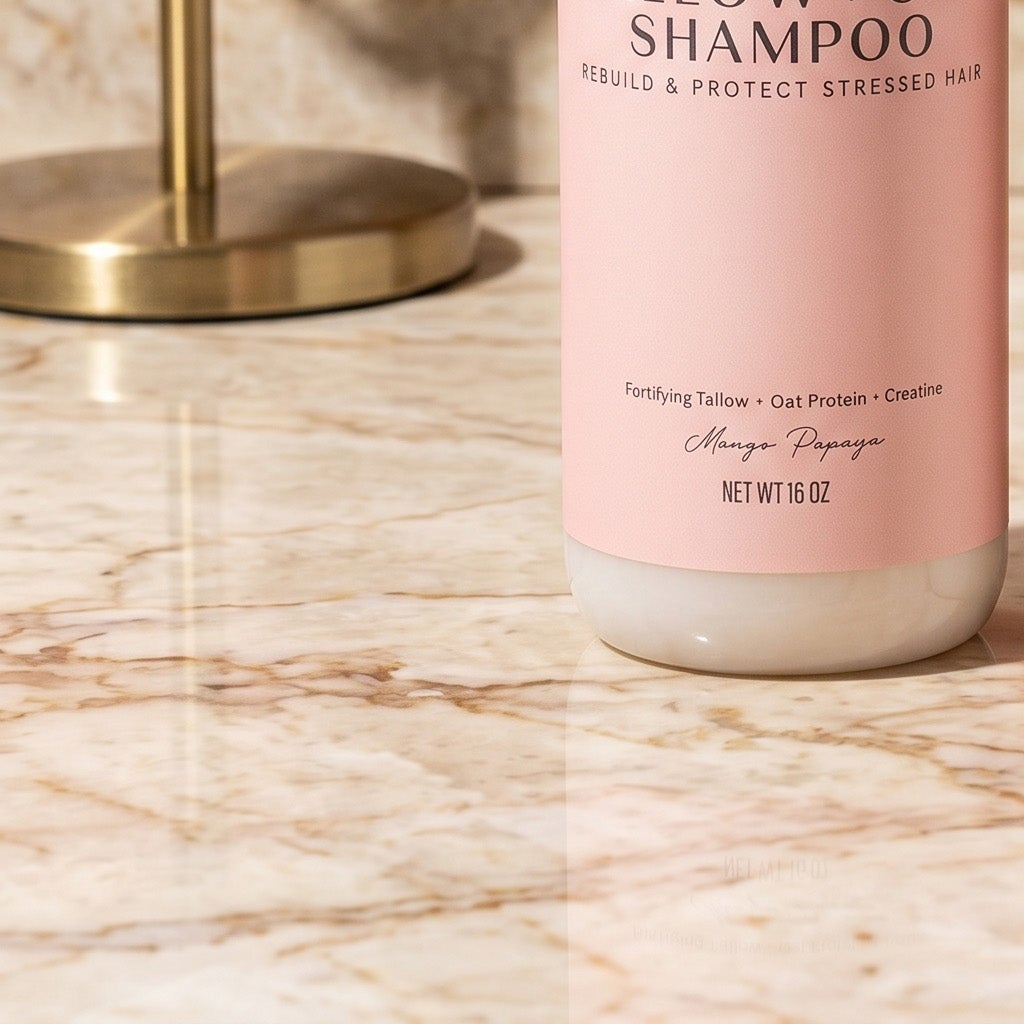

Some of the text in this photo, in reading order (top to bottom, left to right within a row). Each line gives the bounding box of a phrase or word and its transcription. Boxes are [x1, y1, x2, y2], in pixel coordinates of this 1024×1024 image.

[630, 13, 933, 64] SHAMPOO
[582, 63, 982, 99] REBUILD & PROTECT STRESSED HAIR
[625, 381, 943, 409] Fortifying Tallow + Oat Protein + Creatine
[685, 426, 886, 463] Mango Papaya
[722, 480, 831, 505] NET WT 16 OZ
